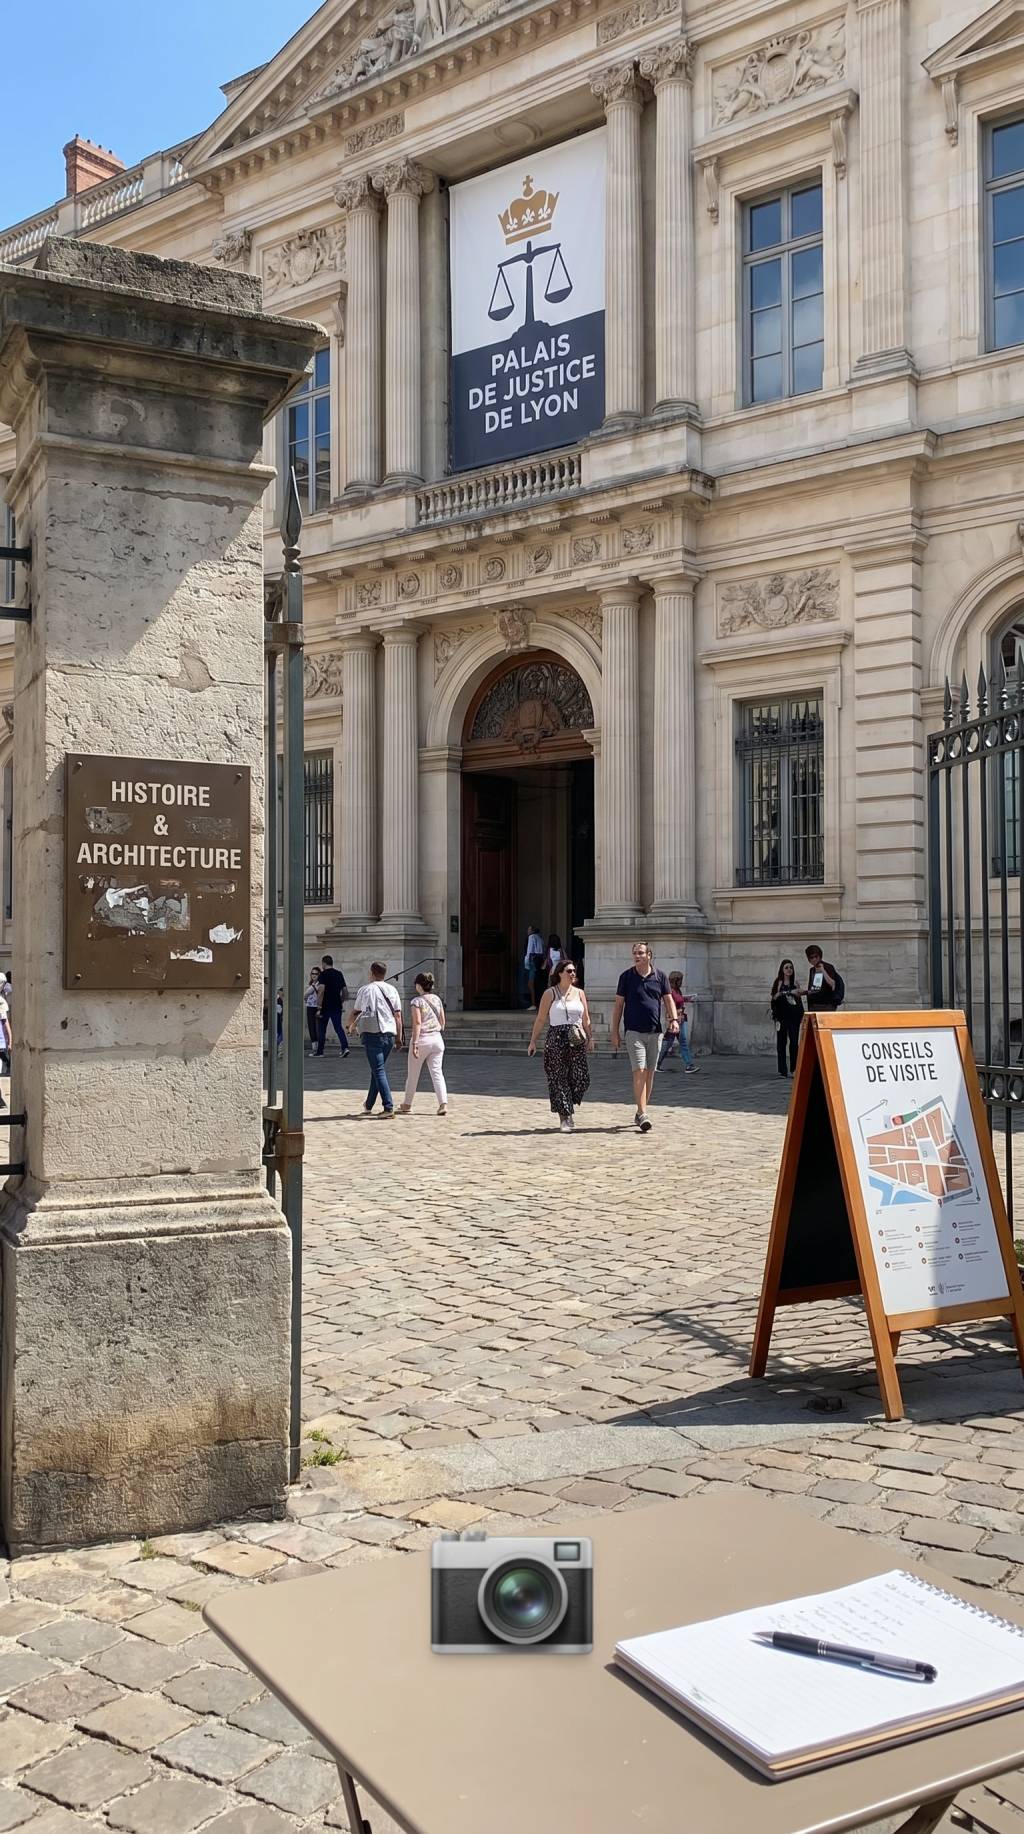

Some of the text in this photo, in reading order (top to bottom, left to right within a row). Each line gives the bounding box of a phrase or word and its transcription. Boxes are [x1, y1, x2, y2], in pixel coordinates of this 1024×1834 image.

[491, 333, 571, 376] PALAIS
[468, 354, 596, 410] DE JUSTICE
[485, 388, 578, 434] DE LYON
[111, 781, 211, 807] HISTOIRE
[153, 814, 169, 836] &
[77, 842, 242, 869] ARCHITECTURE
[861, 1041, 934, 1060] CONSEILS
[866, 1063, 938, 1083] DE VISITE
